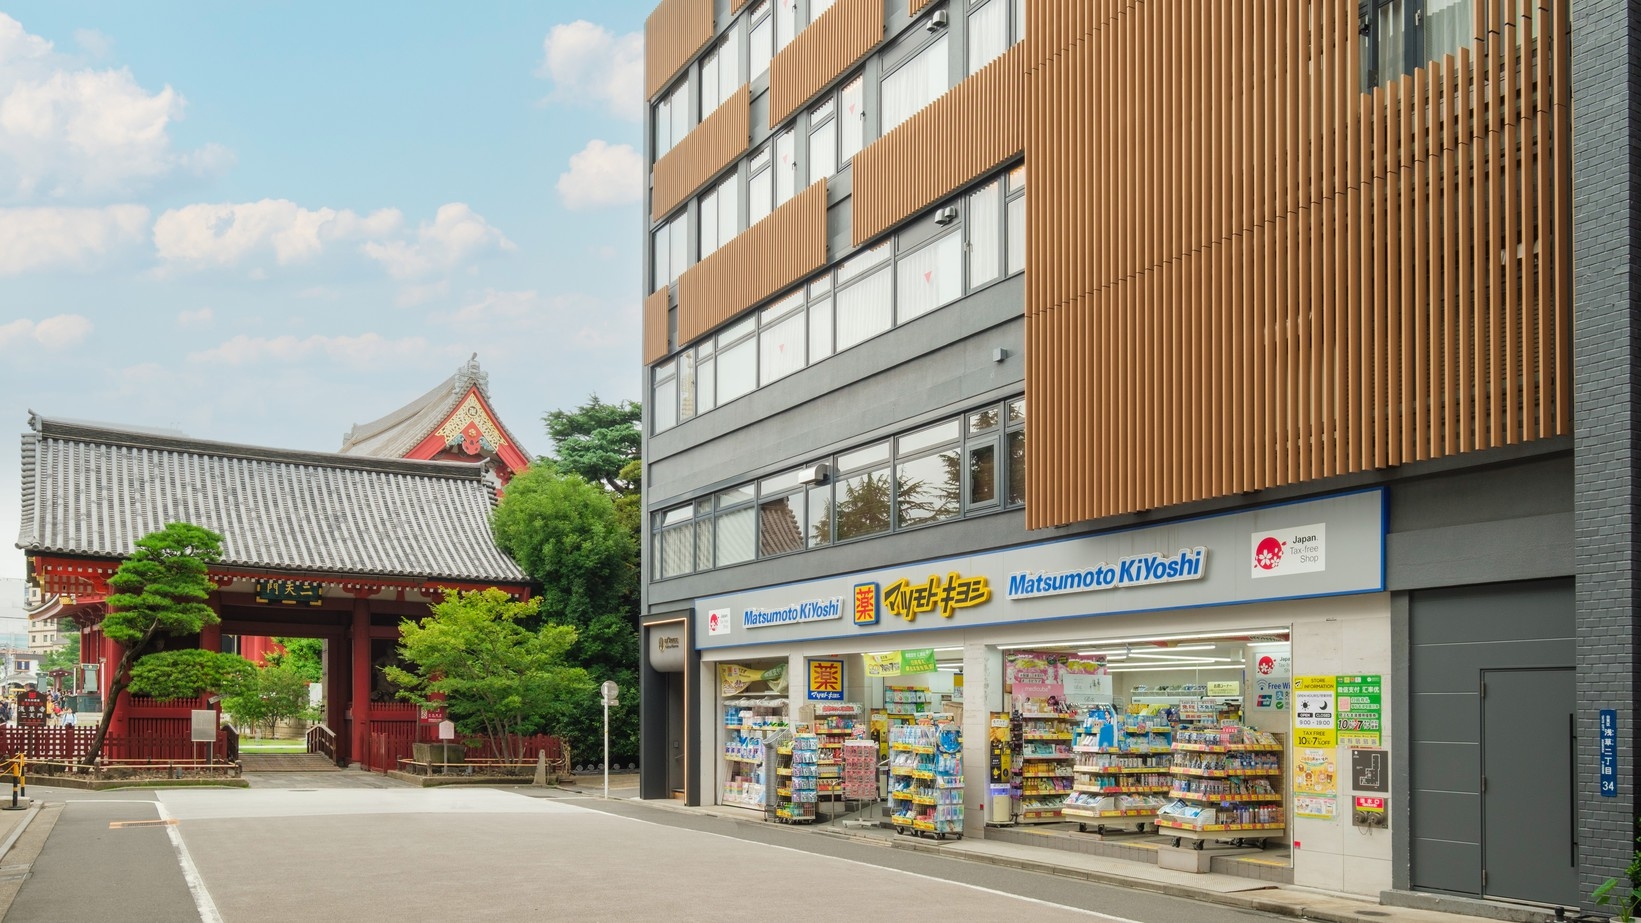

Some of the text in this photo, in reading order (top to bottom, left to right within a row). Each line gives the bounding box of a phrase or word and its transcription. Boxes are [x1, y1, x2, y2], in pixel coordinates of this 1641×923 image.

[1290, 545, 1319, 555] Tax-free
[1300, 555, 1319, 564] Shop
[1008, 550, 1201, 596] Matsumoto KiYoshi
[856, 587, 874, 621] 薬
[884, 575, 986, 618] マツモトキヨシ
[743, 607, 798, 626] Matsumoto
[799, 599, 840, 619] KiYoshi
[814, 662, 838, 690] 薬
[1267, 682, 1281, 690] Free
[1602, 780, 1614, 791] 34
